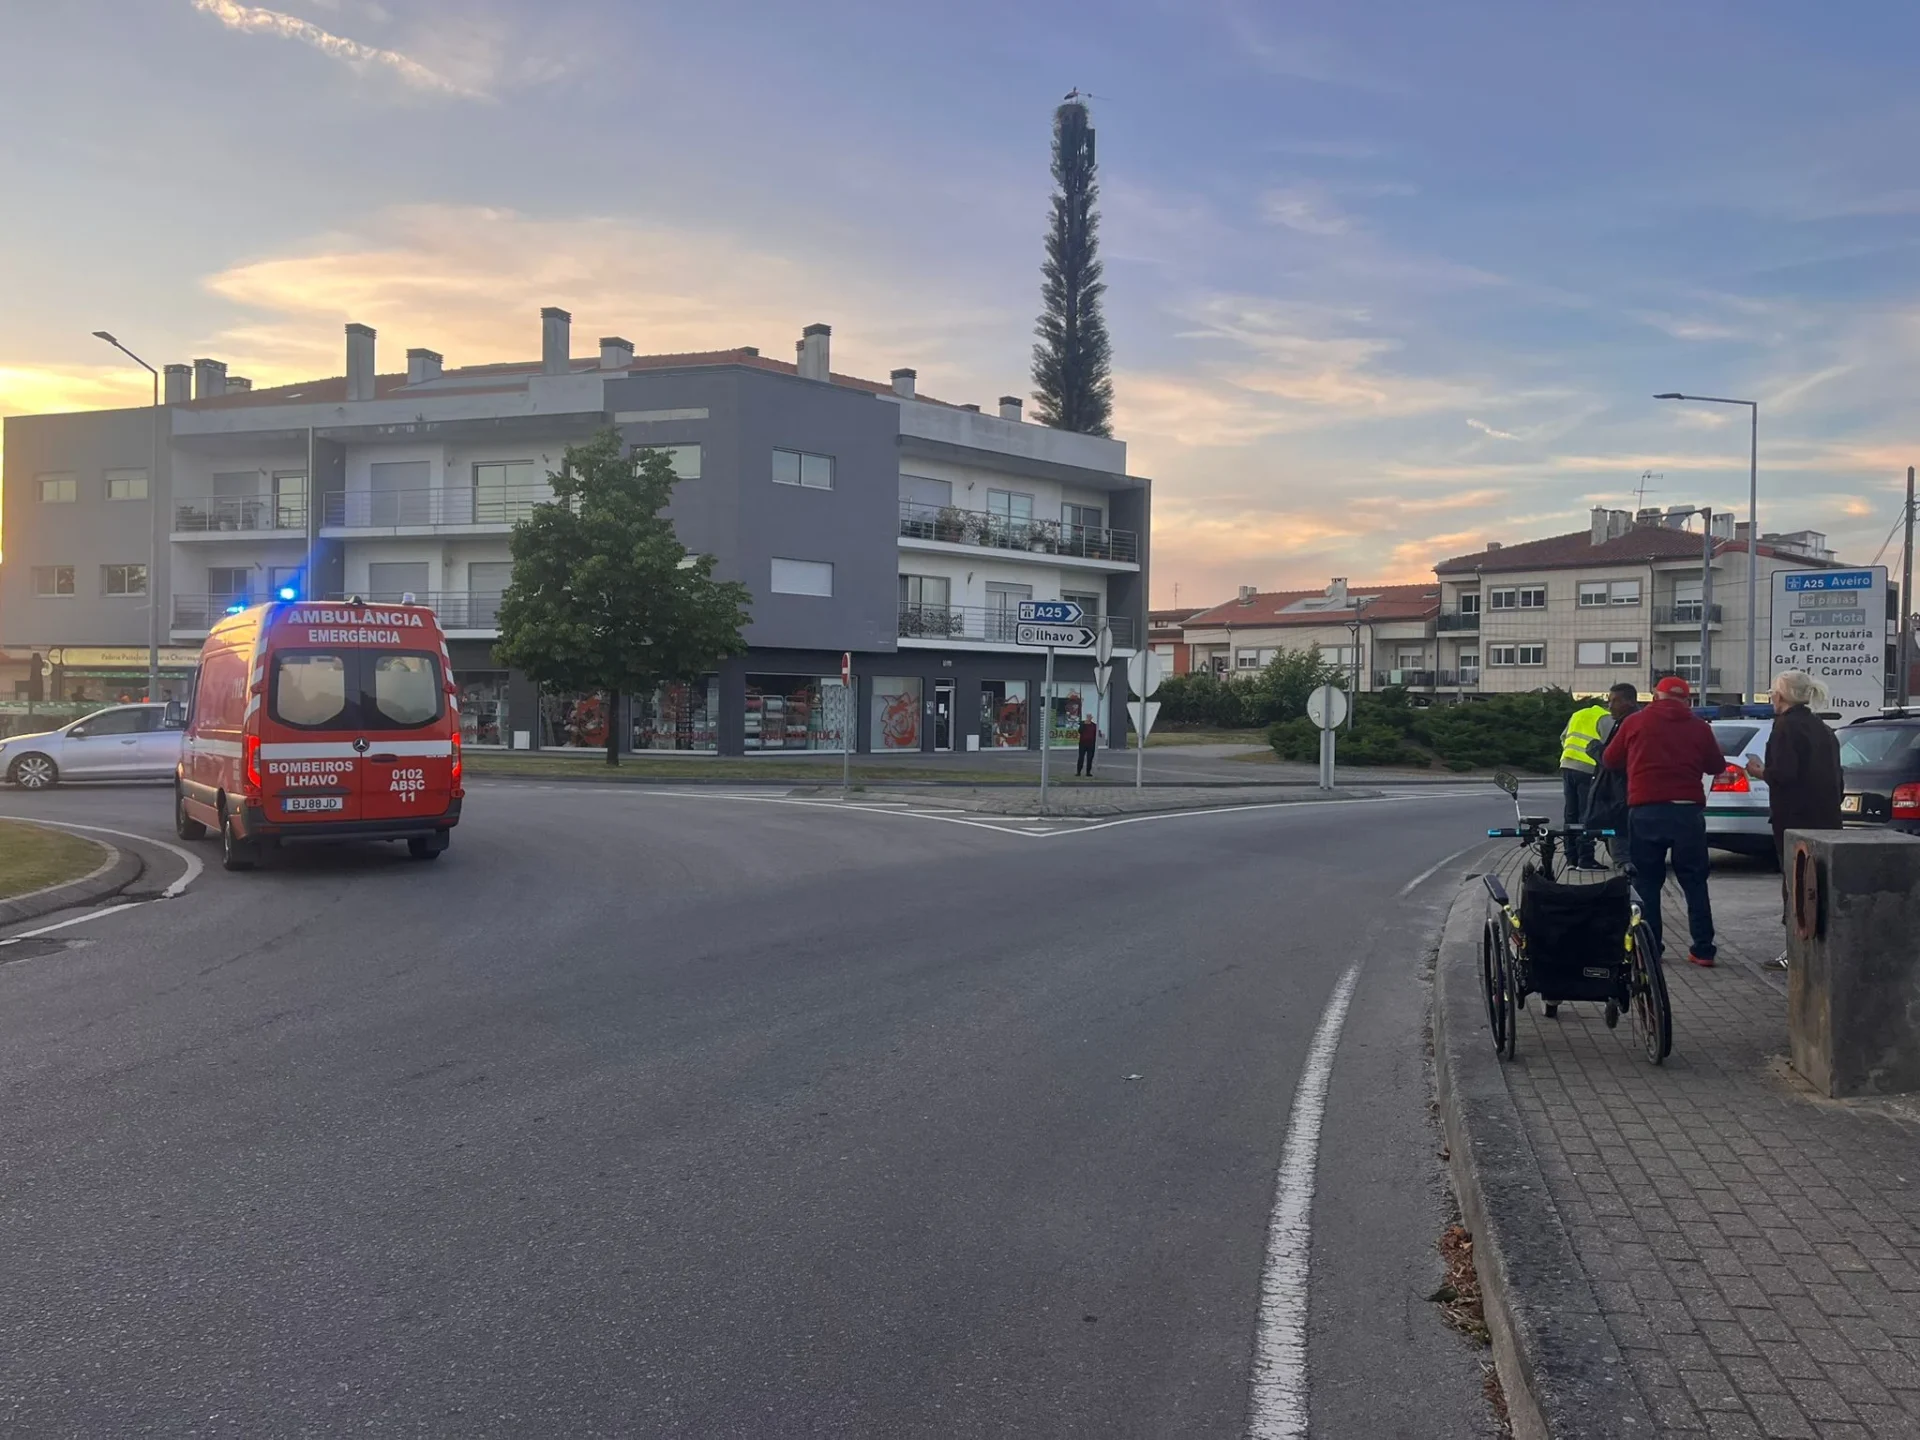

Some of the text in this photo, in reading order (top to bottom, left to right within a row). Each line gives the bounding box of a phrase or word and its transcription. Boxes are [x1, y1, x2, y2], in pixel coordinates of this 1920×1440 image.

[1803, 576, 1870, 589] A25 Aveiro
[1036, 607, 1062, 618] A25
[1832, 613, 1863, 623] Mota
[288, 610, 423, 627] AMBULÂNCIA
[308, 628, 400, 643] EMERGÊNCIA
[1036, 628, 1074, 642] Ílhavo
[1814, 629, 1873, 641] portuária
[1789, 641, 1866, 652] Gaf. Nazaré
[1774, 655, 1880, 666] Gaf. Encarnação
[1821, 667, 1863, 676] Carmo
[1831, 696, 1870, 708] Ílhavo
[269, 761, 354, 773] BOMBEIROS
[286, 773, 338, 787] ÍLHAVO
[391, 769, 423, 780] 0102
[390, 780, 425, 791] ABSC
[399, 792, 415, 803] 11
